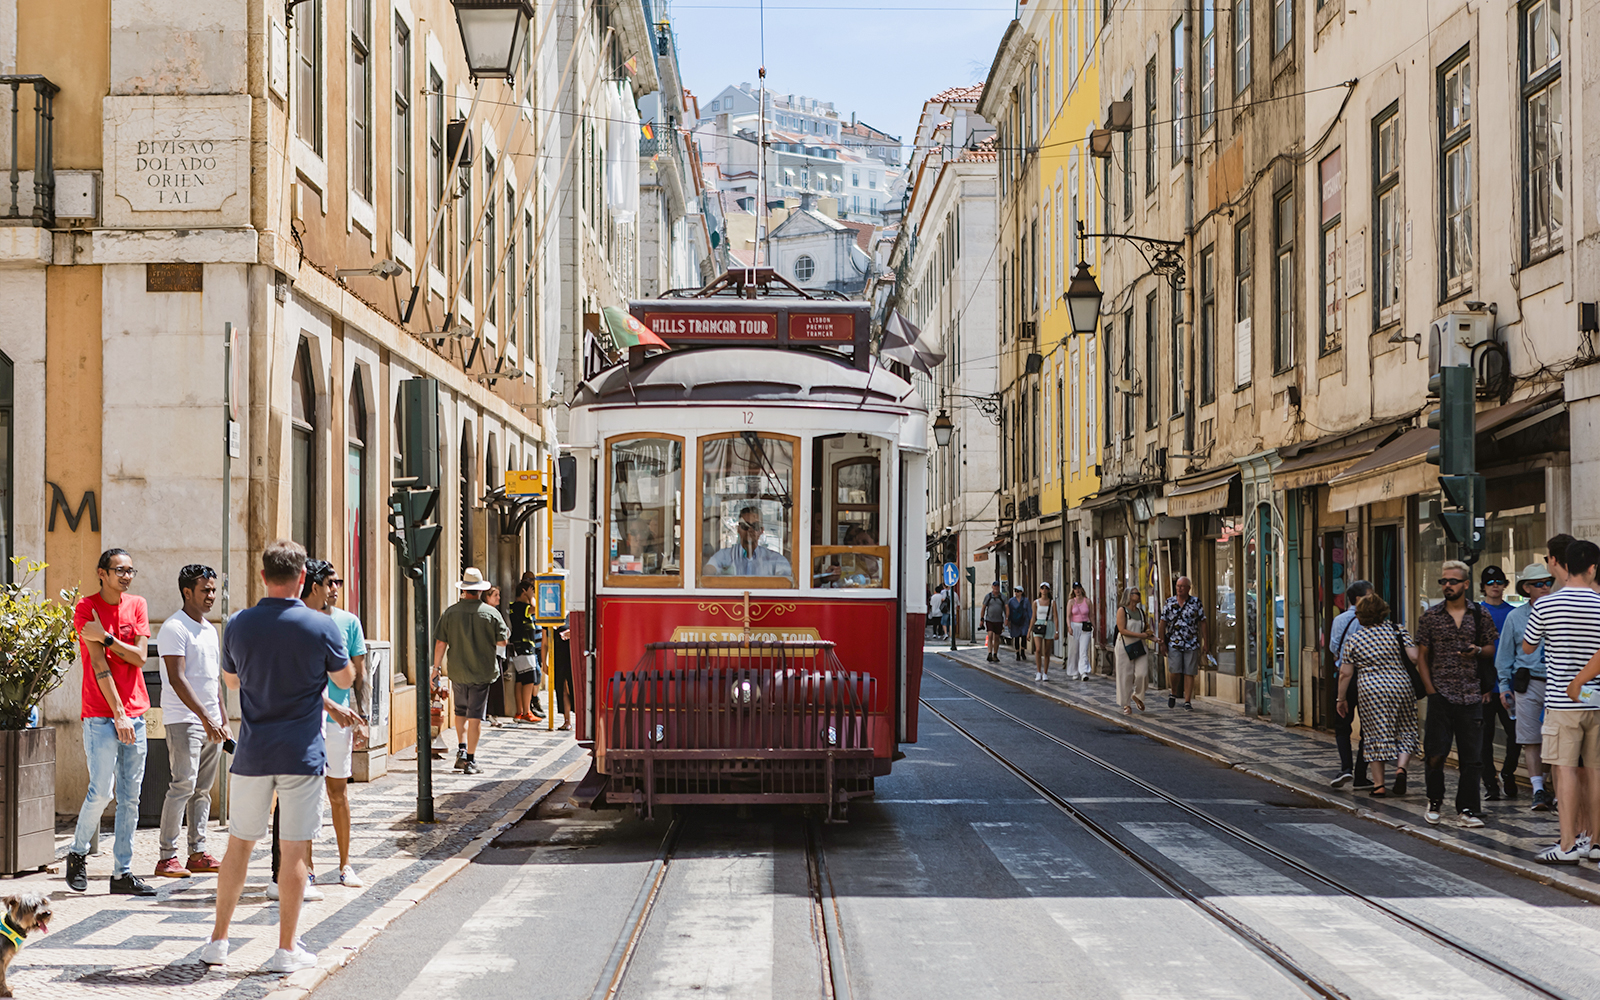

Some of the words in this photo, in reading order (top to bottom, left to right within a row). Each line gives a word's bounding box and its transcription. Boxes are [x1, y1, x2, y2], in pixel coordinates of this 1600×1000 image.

[155, 190, 196, 204] TAL
[652, 319, 686, 334] HILLS
[688, 319, 737, 334] TRAMCAR
[739, 320, 769, 335] TOUR
[742, 411, 754, 425] 12
[46, 481, 99, 533] M
